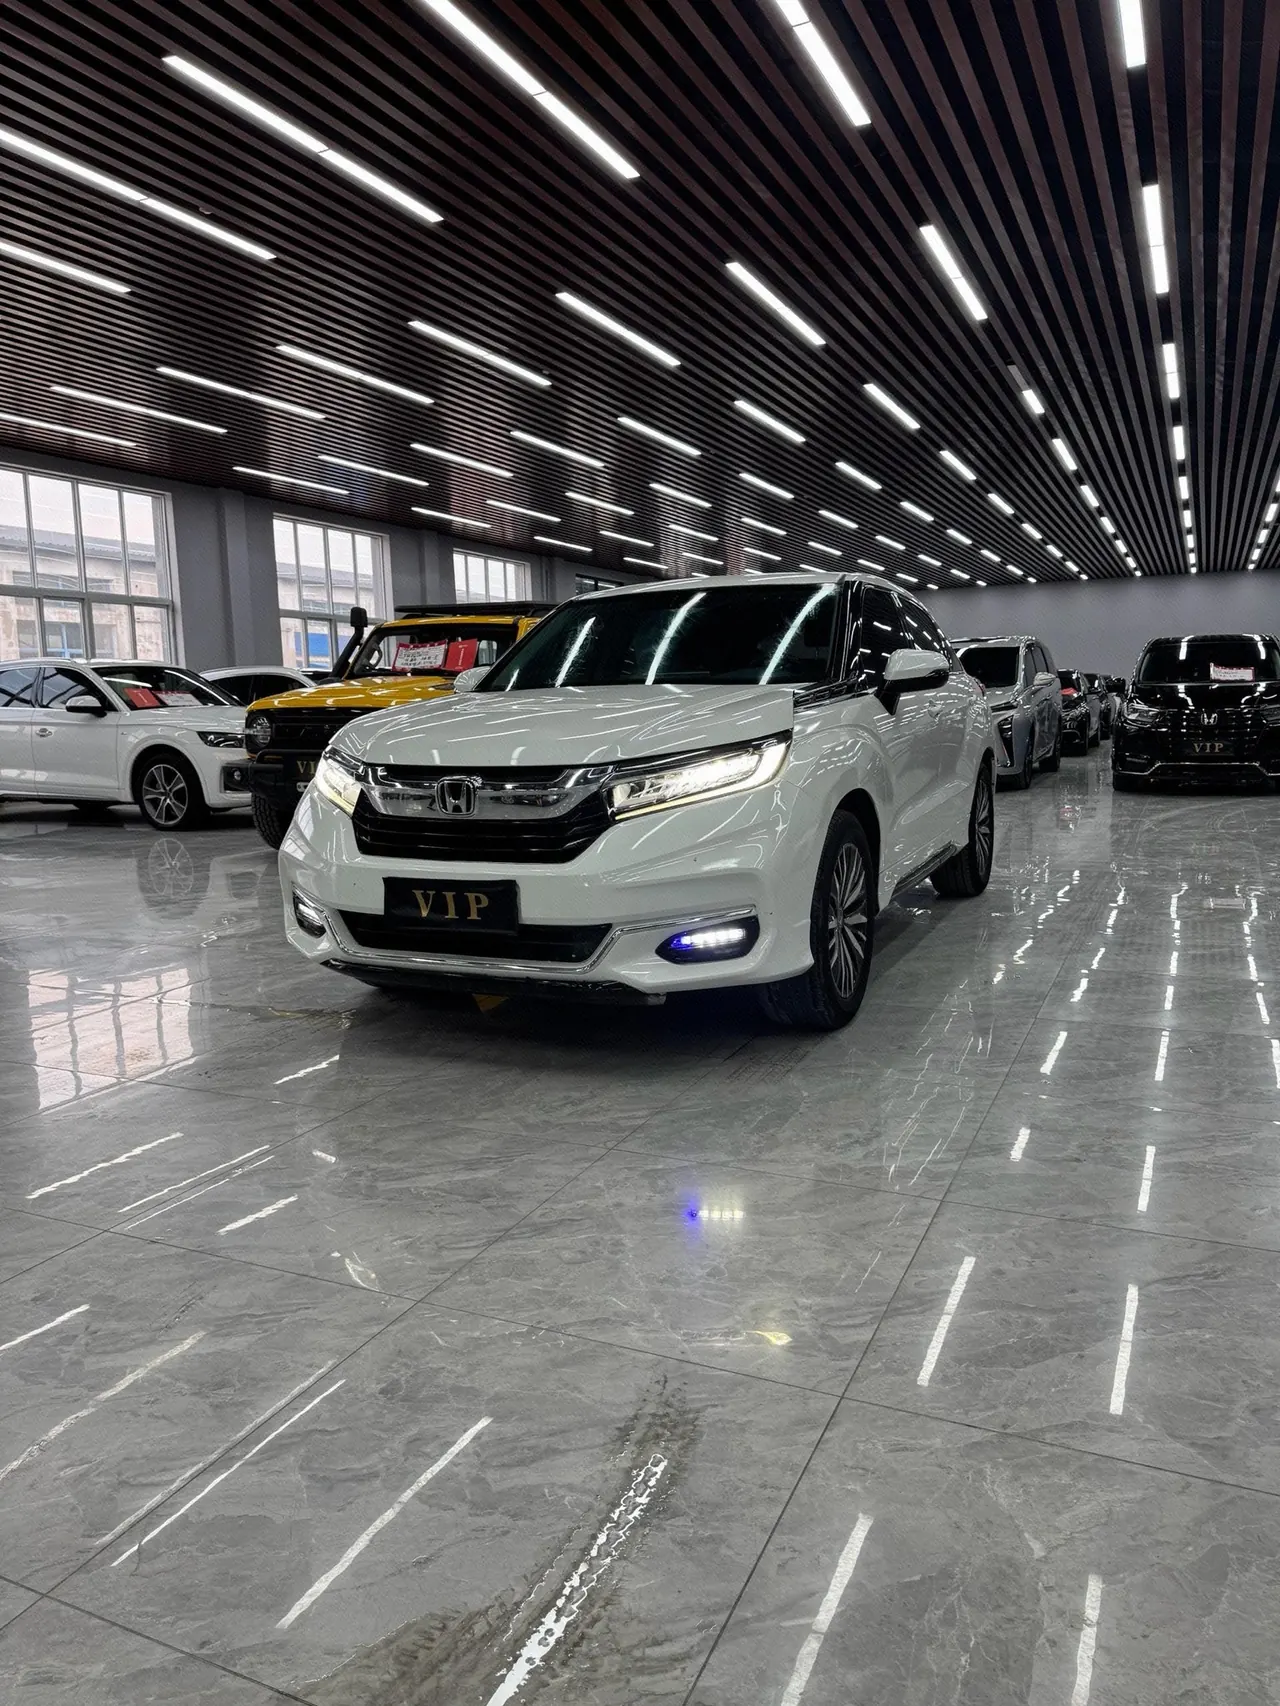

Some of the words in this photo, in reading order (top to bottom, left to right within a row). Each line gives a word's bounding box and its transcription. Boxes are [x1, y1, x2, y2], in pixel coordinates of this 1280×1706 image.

[1193, 742, 1225, 753] VIP
[296, 760, 316, 774] VI
[411, 889, 489, 920] VIP
